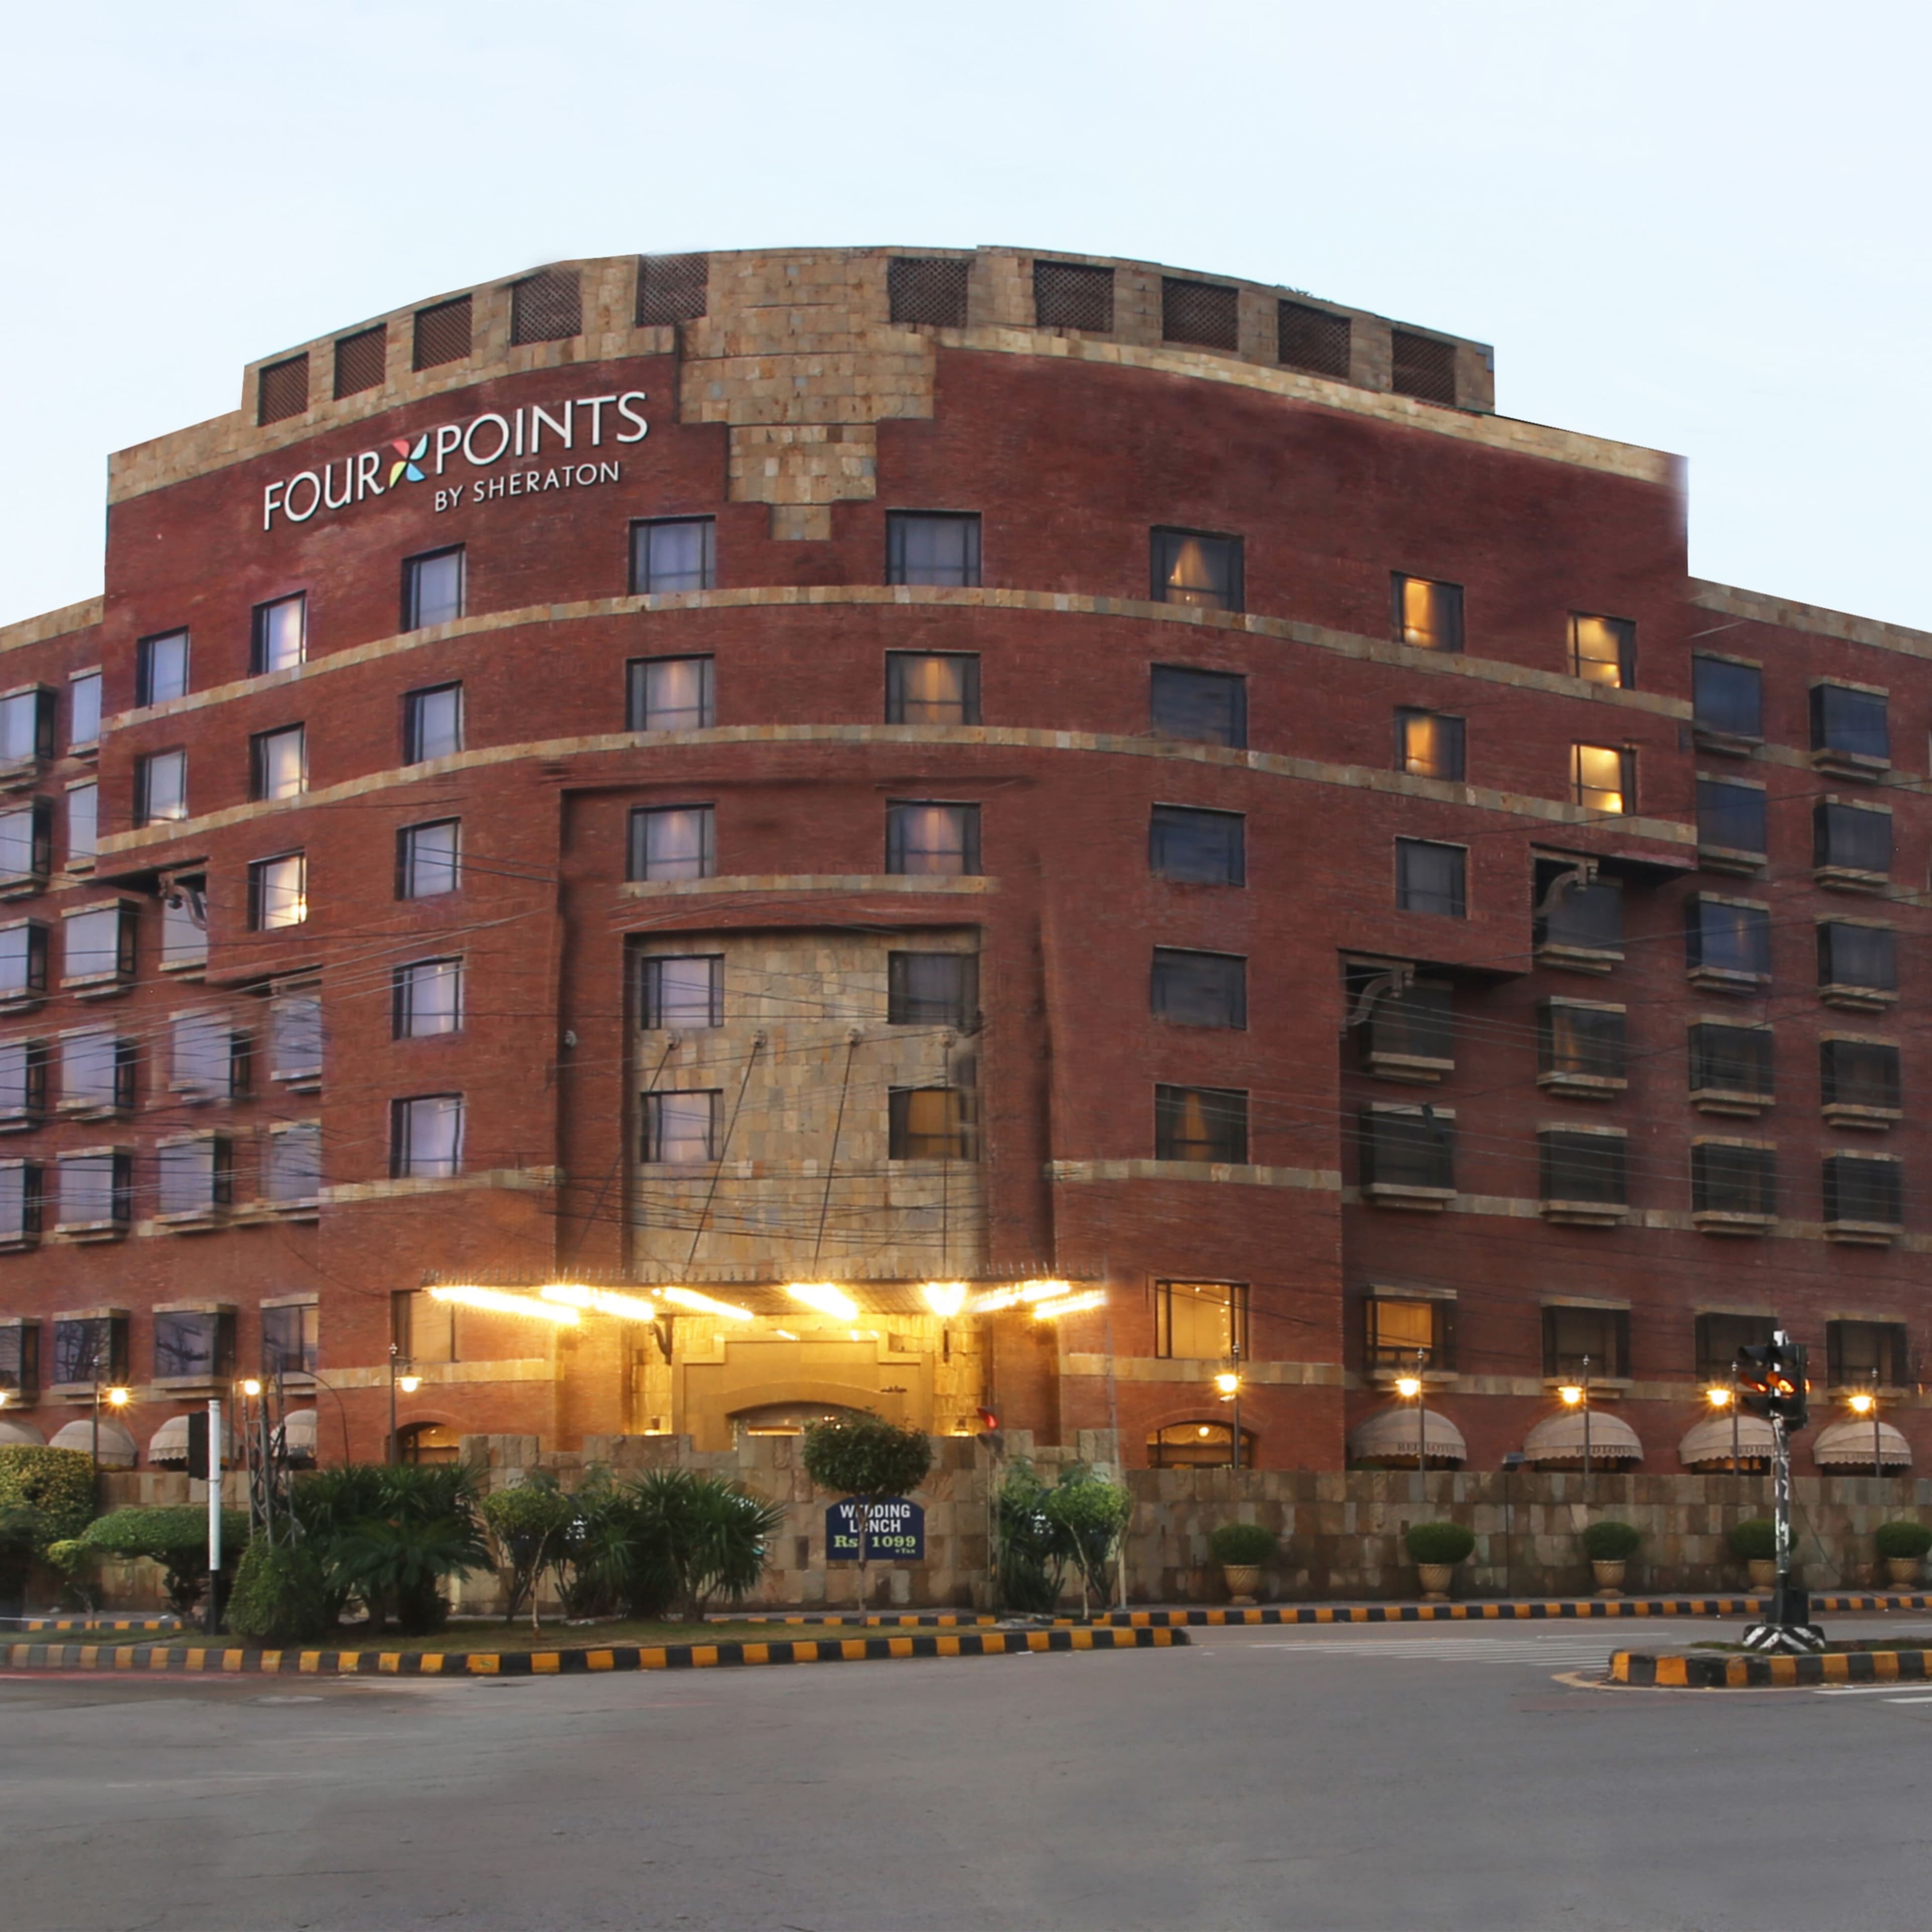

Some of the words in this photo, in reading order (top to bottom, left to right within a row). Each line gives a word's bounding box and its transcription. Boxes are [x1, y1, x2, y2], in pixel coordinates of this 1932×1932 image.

[263, 451, 385, 531] FOUR
[436, 391, 648, 474] POINTS
[435, 485, 464, 512] BY
[473, 461, 619, 503] SHERATON
[1576, 1445, 1600, 1454] RD
[850, 1519, 901, 1533] LNCH
[872, 1536, 916, 1548] 1099
